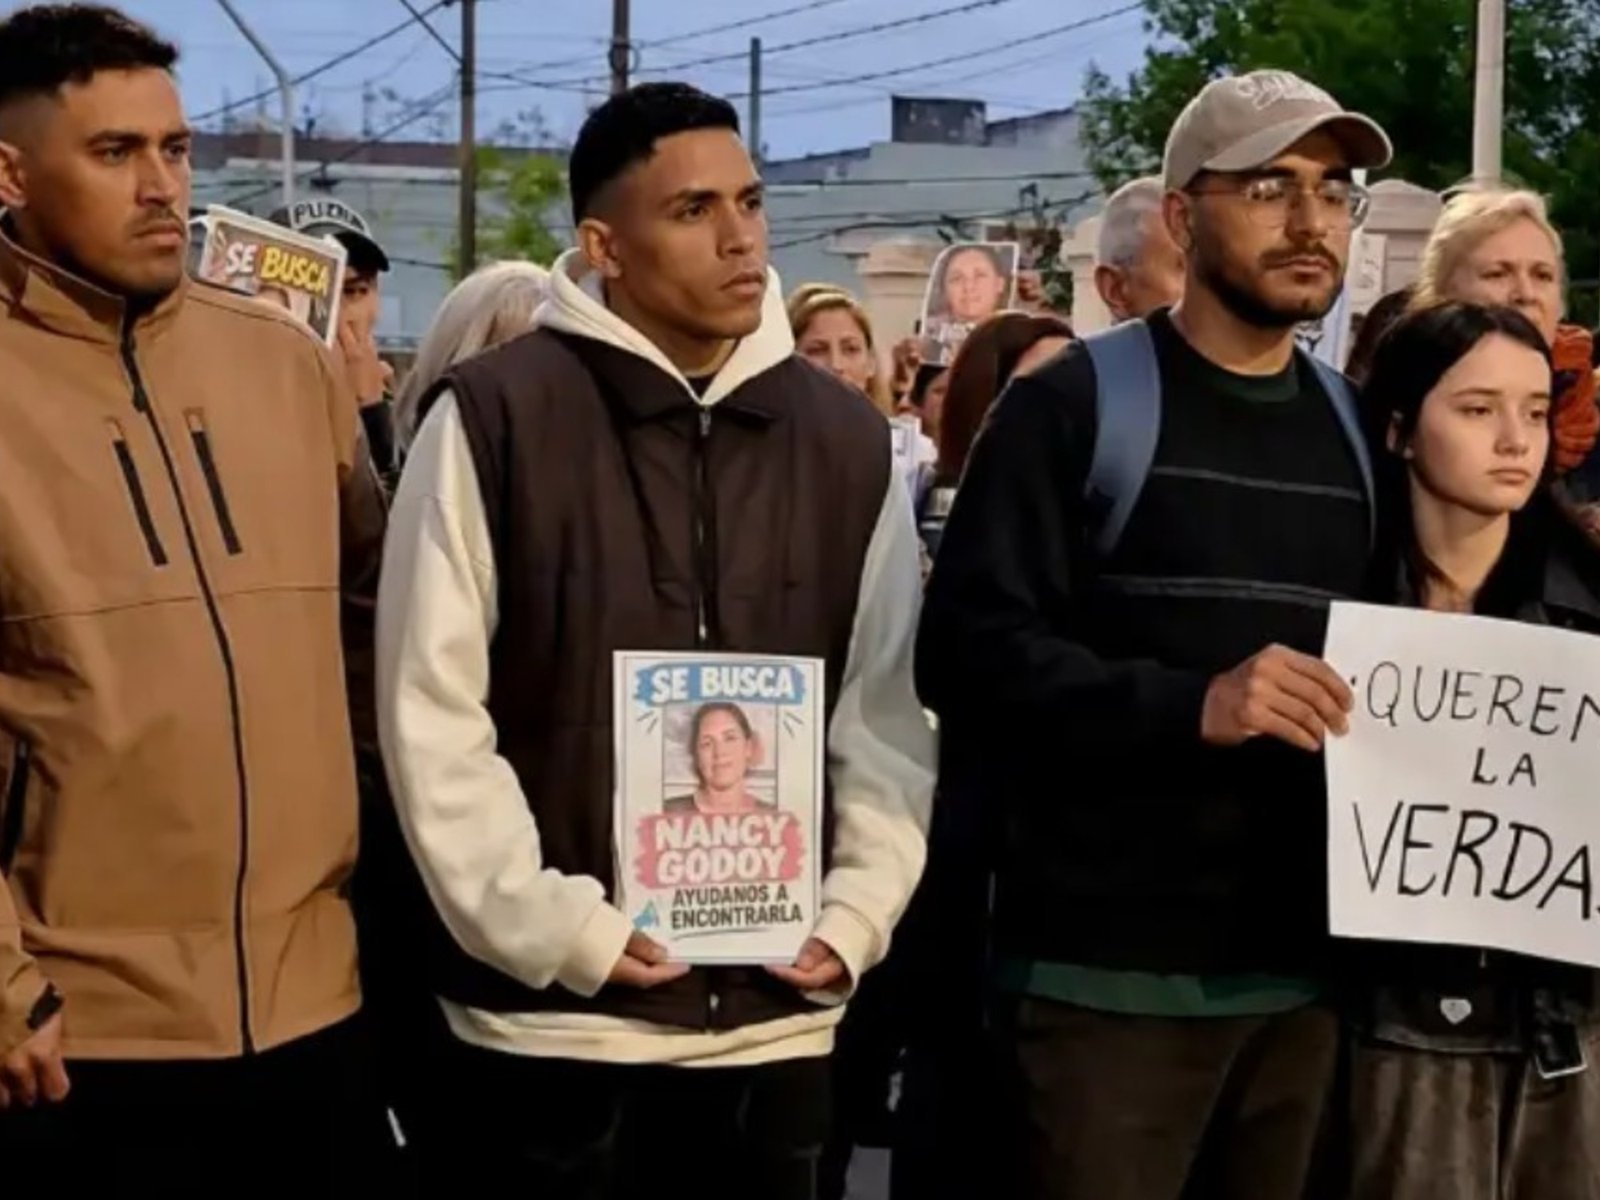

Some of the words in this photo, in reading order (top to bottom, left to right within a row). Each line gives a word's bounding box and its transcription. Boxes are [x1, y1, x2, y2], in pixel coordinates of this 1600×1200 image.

[225, 242, 257, 275] SE
[261, 246, 329, 296] BUSCA
[652, 667, 689, 702] SE
[701, 666, 795, 698] BUSCA
[1472, 747, 1537, 787] LA
[655, 814, 790, 850] NANCY
[657, 847, 787, 885] GODOY
[1353, 800, 1600, 921] VERDA
[672, 885, 769, 908] AYUDANOS
[777, 884, 789, 900] A
[671, 905, 803, 930] ENCONTRARLA
